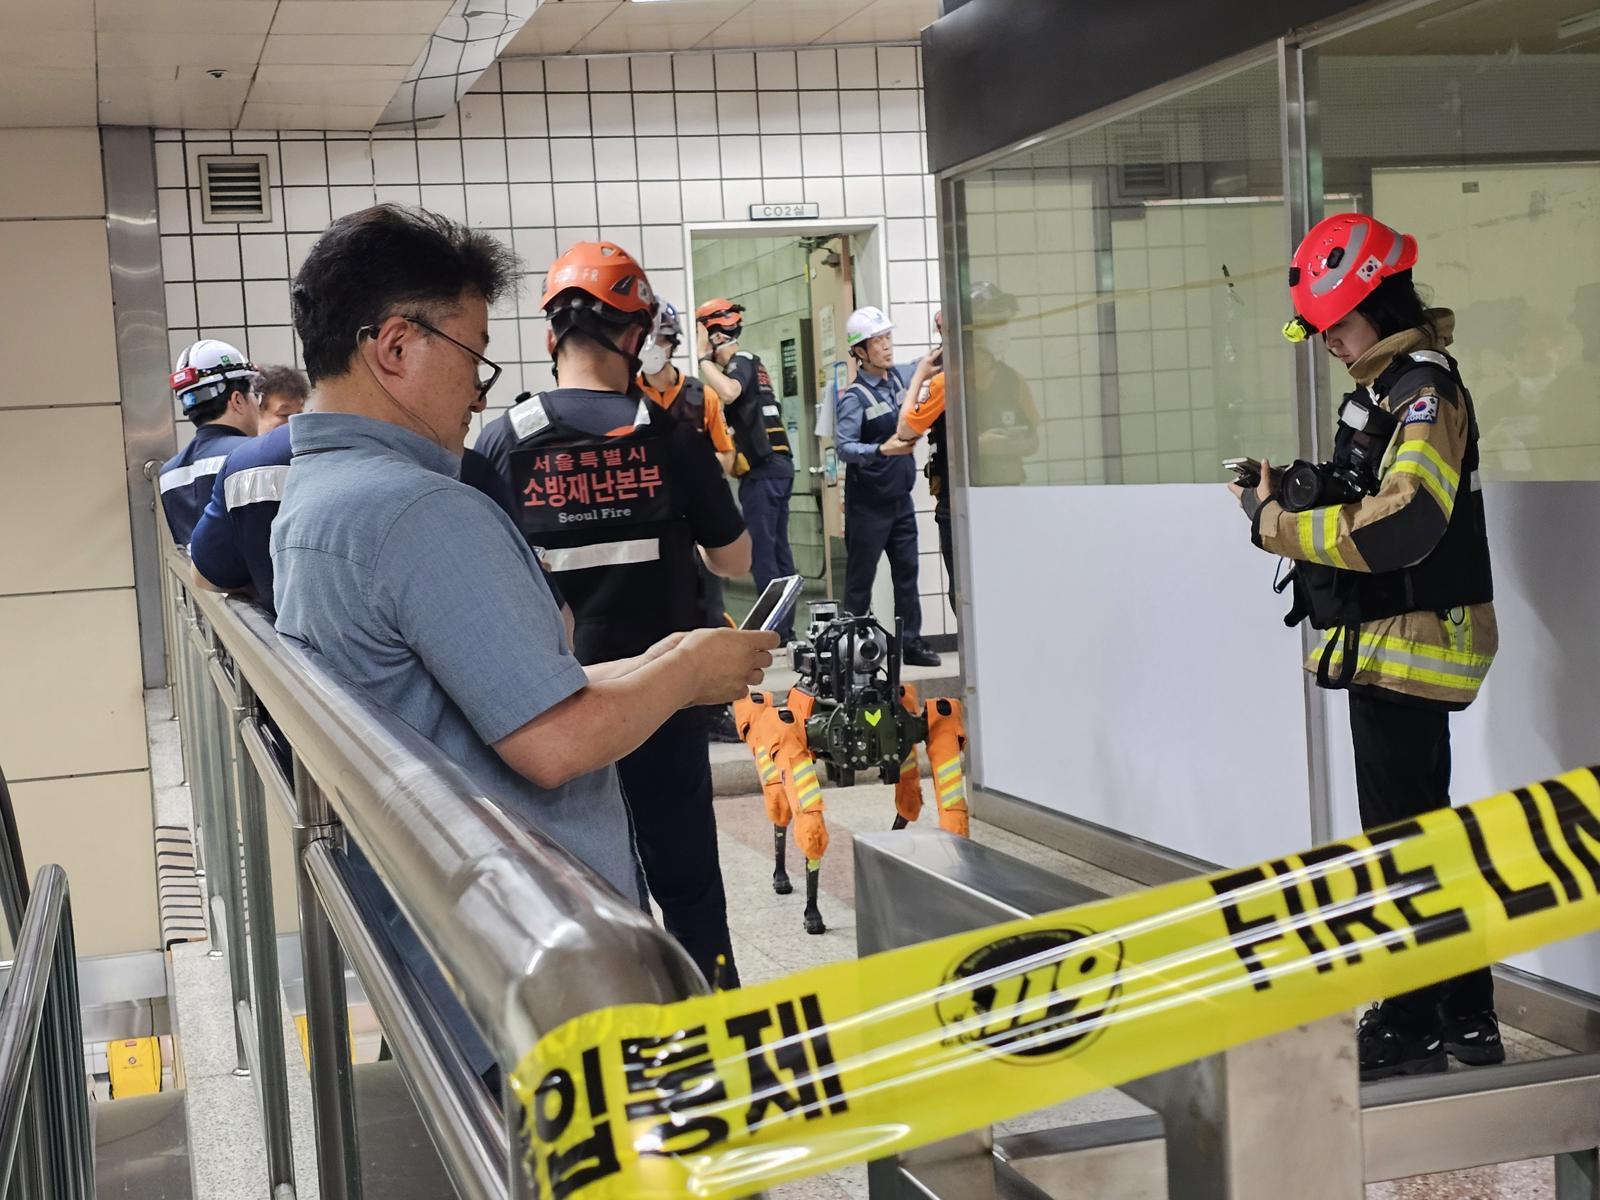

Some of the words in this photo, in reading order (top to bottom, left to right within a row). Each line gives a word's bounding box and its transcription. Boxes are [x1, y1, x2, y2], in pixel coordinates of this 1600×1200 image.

[763, 205, 804, 217] CO2실
[1405, 415, 1433, 423] KOREA
[533, 446, 647, 473] 서울특별시
[523, 465, 663, 508] 소방재난본부
[558, 509, 598, 524] Seoul
[602, 507, 632, 520] Fire
[1209, 820, 1471, 992] FIRE
[517, 994, 848, 1200] 입통제
